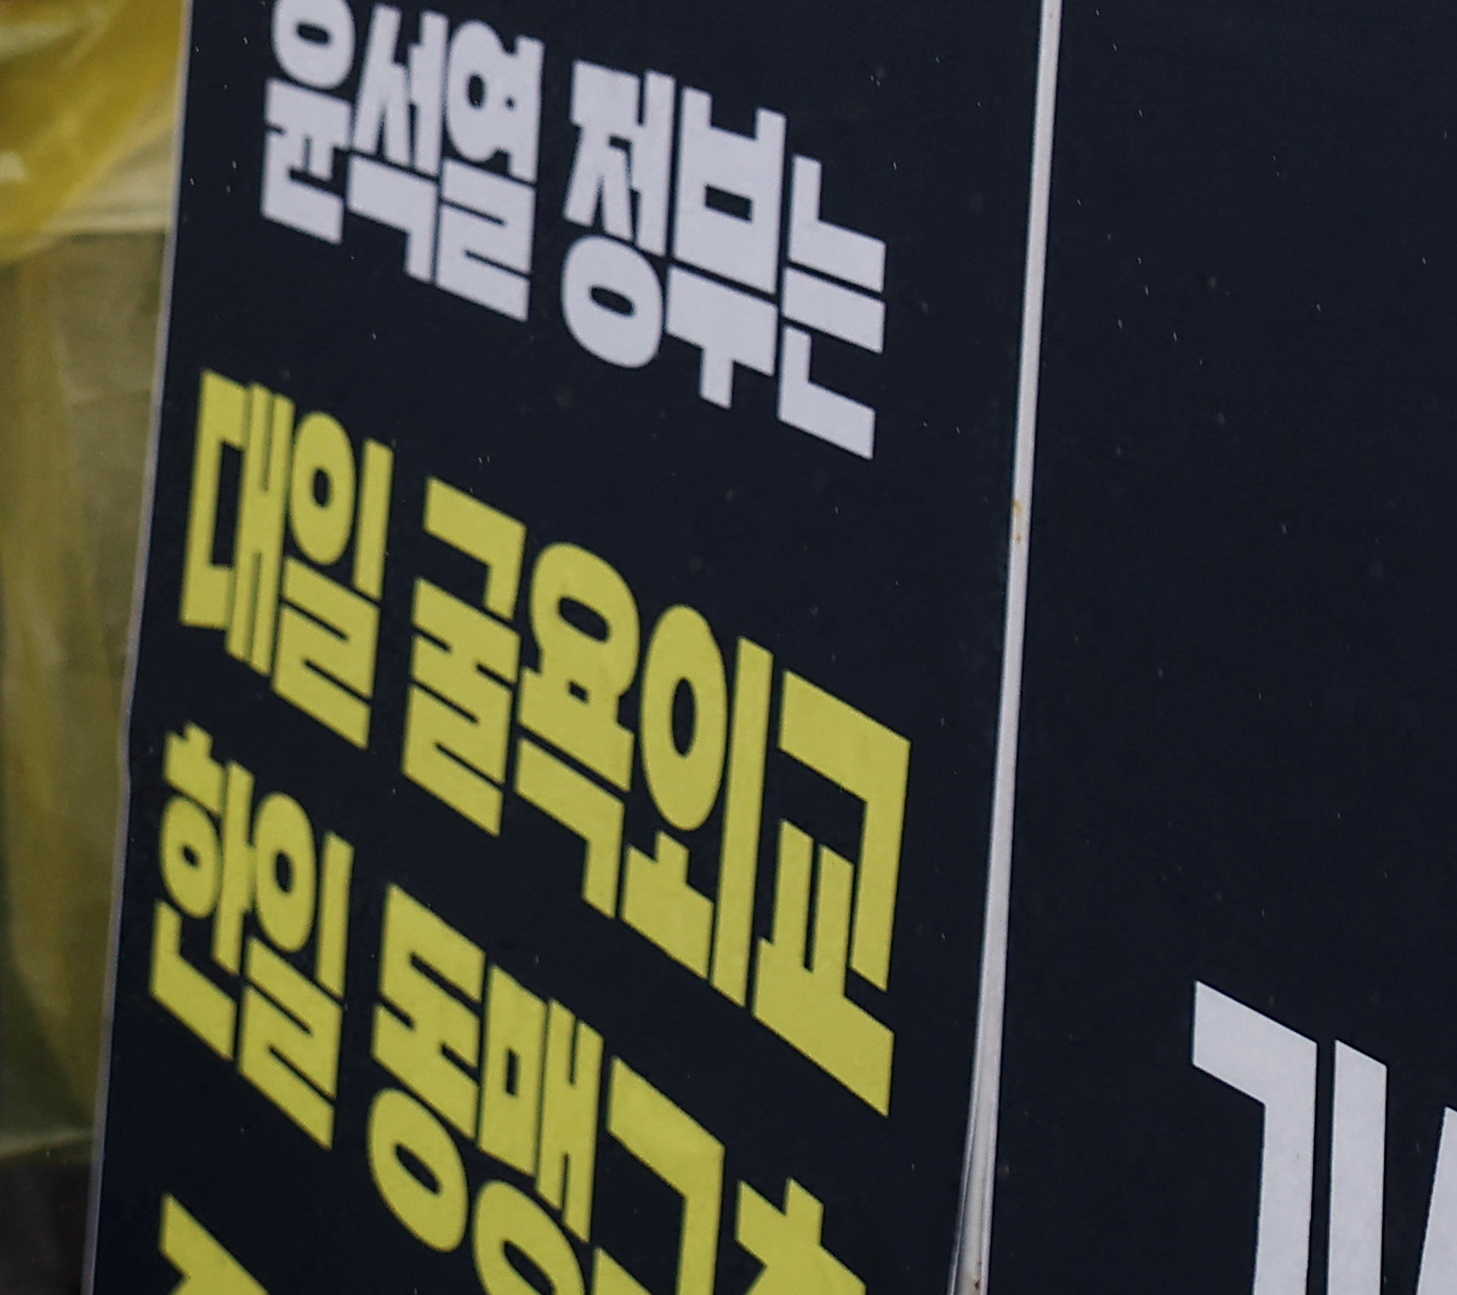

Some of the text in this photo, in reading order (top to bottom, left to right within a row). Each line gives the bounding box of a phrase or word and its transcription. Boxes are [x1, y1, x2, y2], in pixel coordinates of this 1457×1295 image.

[560, 60, 888, 460] 정부는
[149, 721, 355, 1151] 한일
[179, 368, 913, 1118] 대일 굴욕외교
